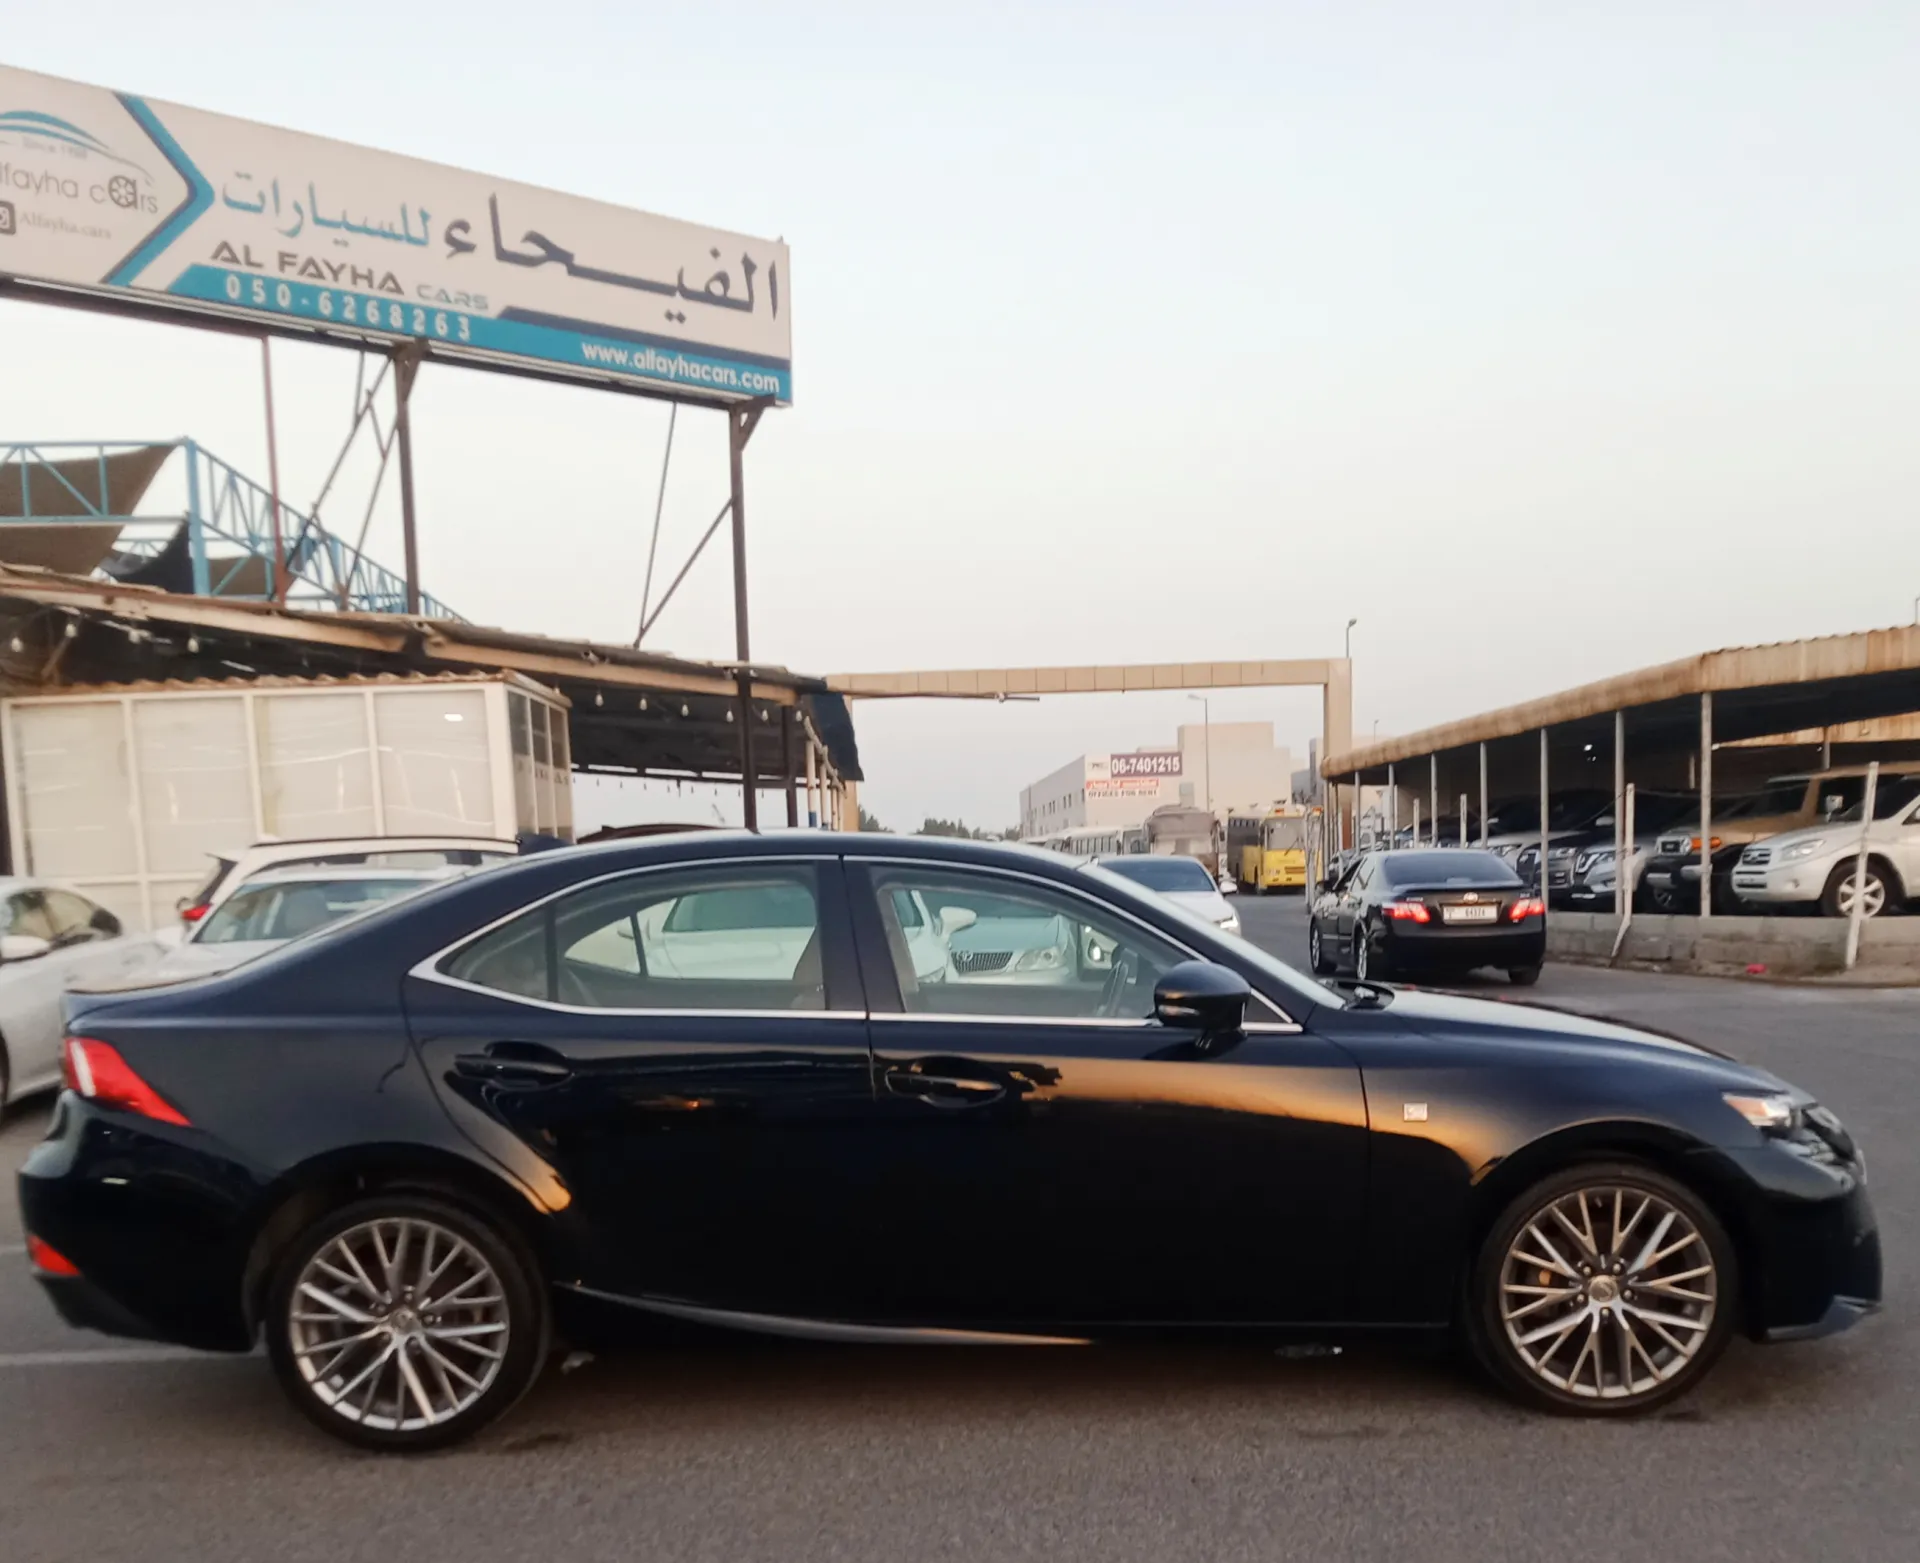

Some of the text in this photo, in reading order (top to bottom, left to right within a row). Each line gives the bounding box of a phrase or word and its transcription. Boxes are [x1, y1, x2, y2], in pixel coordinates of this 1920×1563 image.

[89, 174, 159, 214] cars
[222, 170, 431, 248] للسيارات
[210, 240, 490, 311] AL FAYHA CARS
[1111, 756, 1180, 774] 06-7401215
